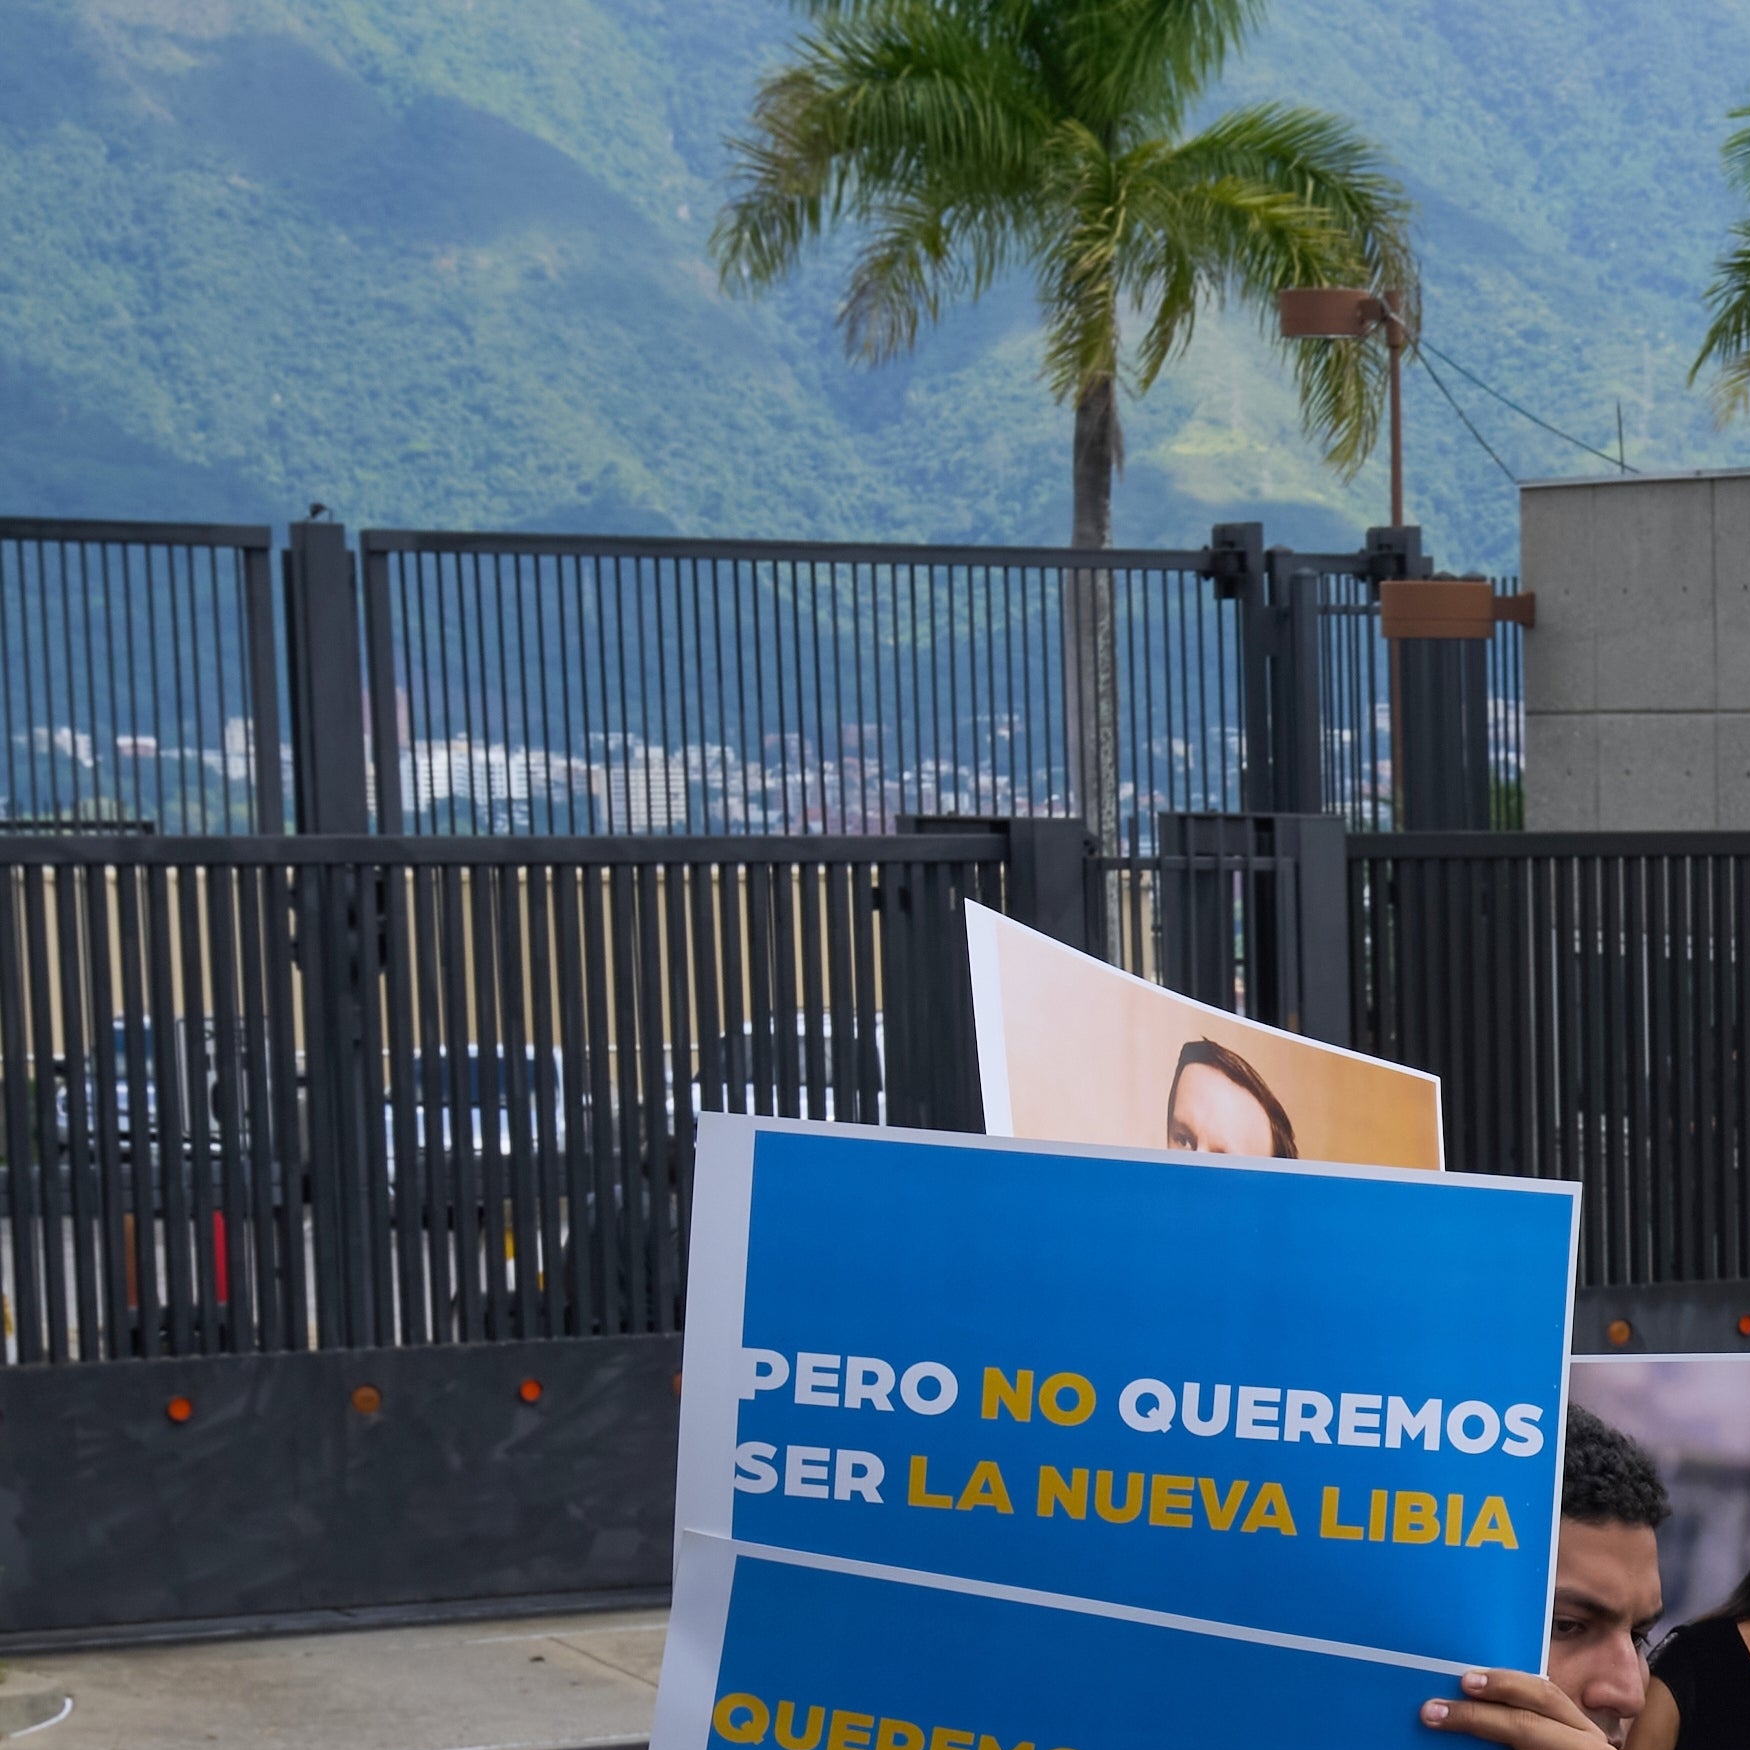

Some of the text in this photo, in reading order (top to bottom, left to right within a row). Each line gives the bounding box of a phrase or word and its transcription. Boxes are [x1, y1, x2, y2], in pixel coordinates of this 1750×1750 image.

[738, 1348, 1546, 1458] PERO NO QUEREMOS
[733, 1441, 1519, 1550] SER LA NUEVA LIBIA
